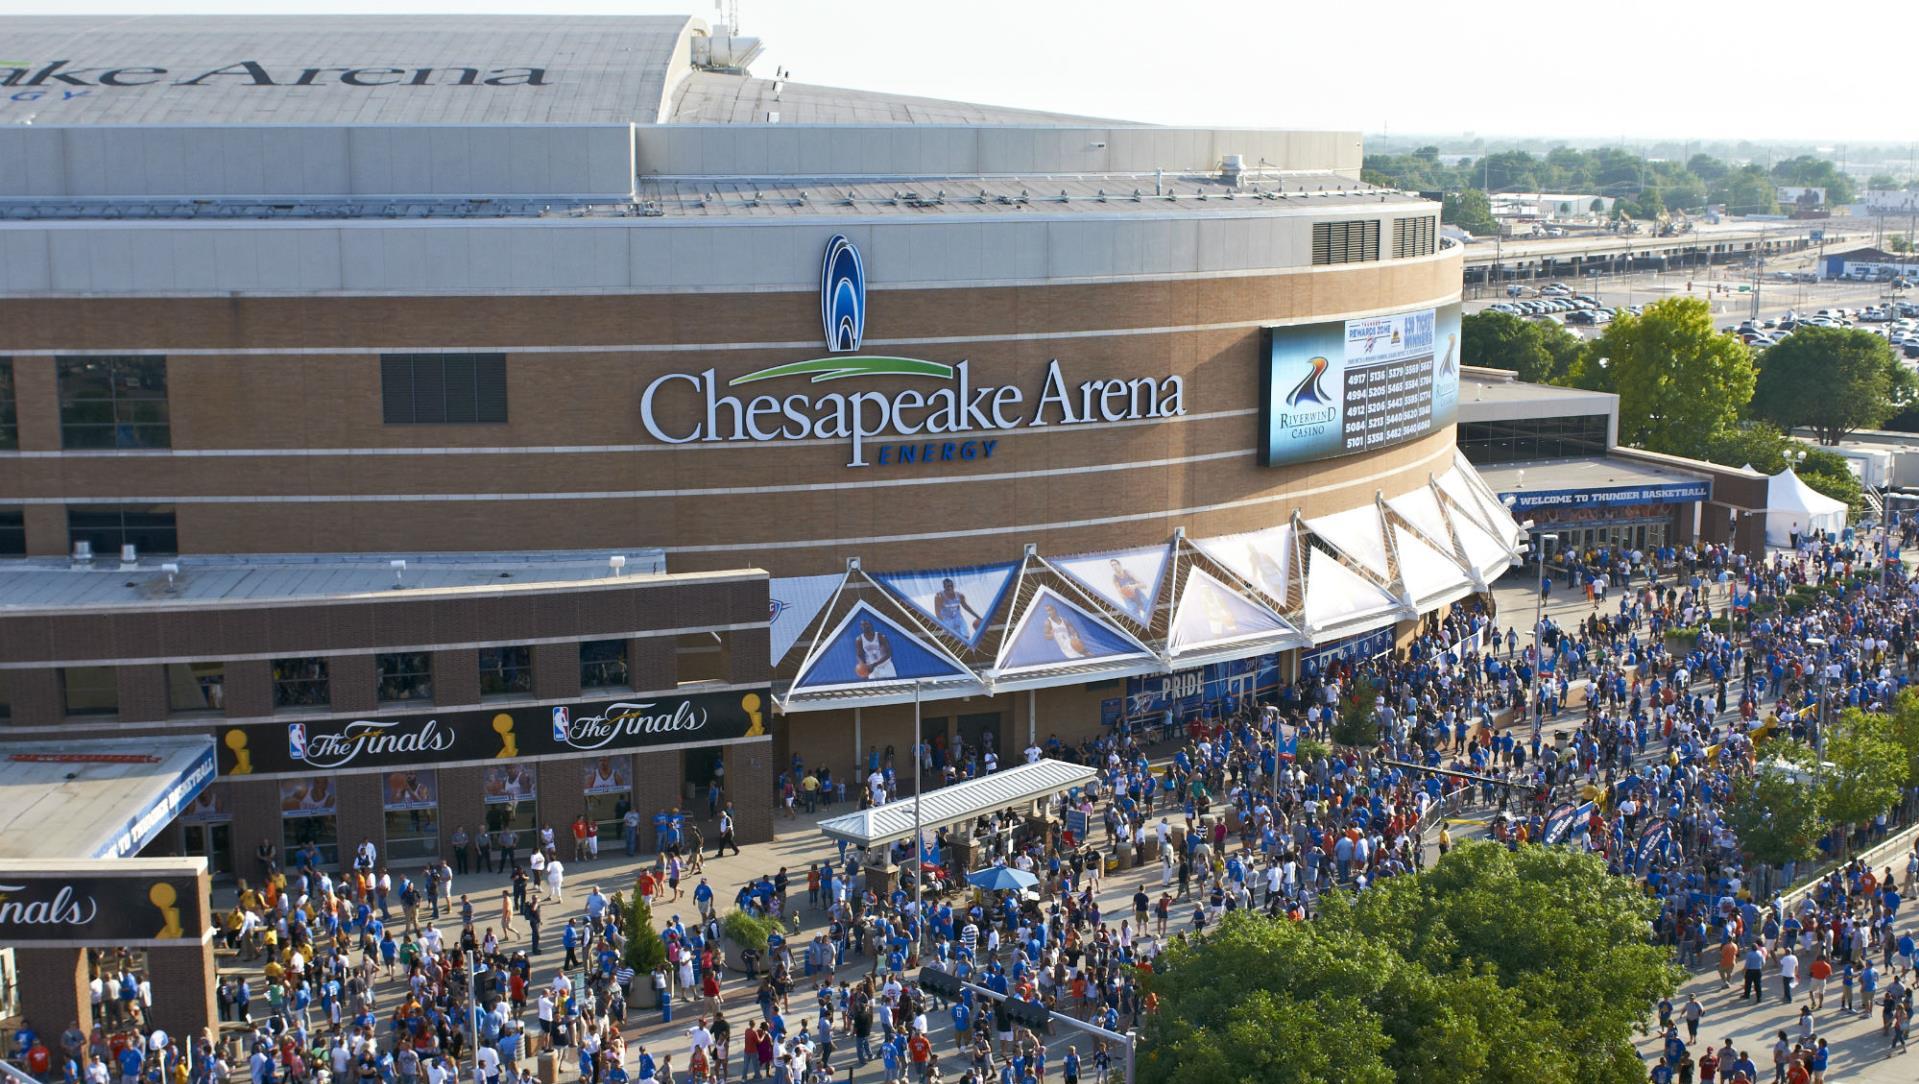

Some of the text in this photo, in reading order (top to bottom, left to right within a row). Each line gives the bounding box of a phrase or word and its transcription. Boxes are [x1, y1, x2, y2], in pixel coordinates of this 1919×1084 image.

[170, 61, 553, 86] Arena
[1349, 324, 1391, 338] REWARDS ZONE
[1404, 331, 1433, 349] WINNERS
[1347, 373, 1366, 385] 4917
[1346, 389, 1366, 401] 4994
[1368, 385, 1386, 398] 5205
[639, 359, 1186, 467] Chesapeake Arena
[1280, 406, 1336, 429] RIVERWIND
[1346, 405, 1365, 417] 4912
[1291, 425, 1325, 439] CASINO
[1368, 416, 1384, 429] 5213
[877, 440, 999, 465] ENERGY
[1346, 436, 1364, 448] 5101
[1519, 487, 1707, 506] WELCOME TO THUNDER BASKETBALL
[1162, 671, 1205, 701] PRIDE
[570, 700, 707, 746] The Finals
[307, 719, 455, 765] The Finals
[117, 832, 132, 856] TO
[0, 885, 97, 926] nals
